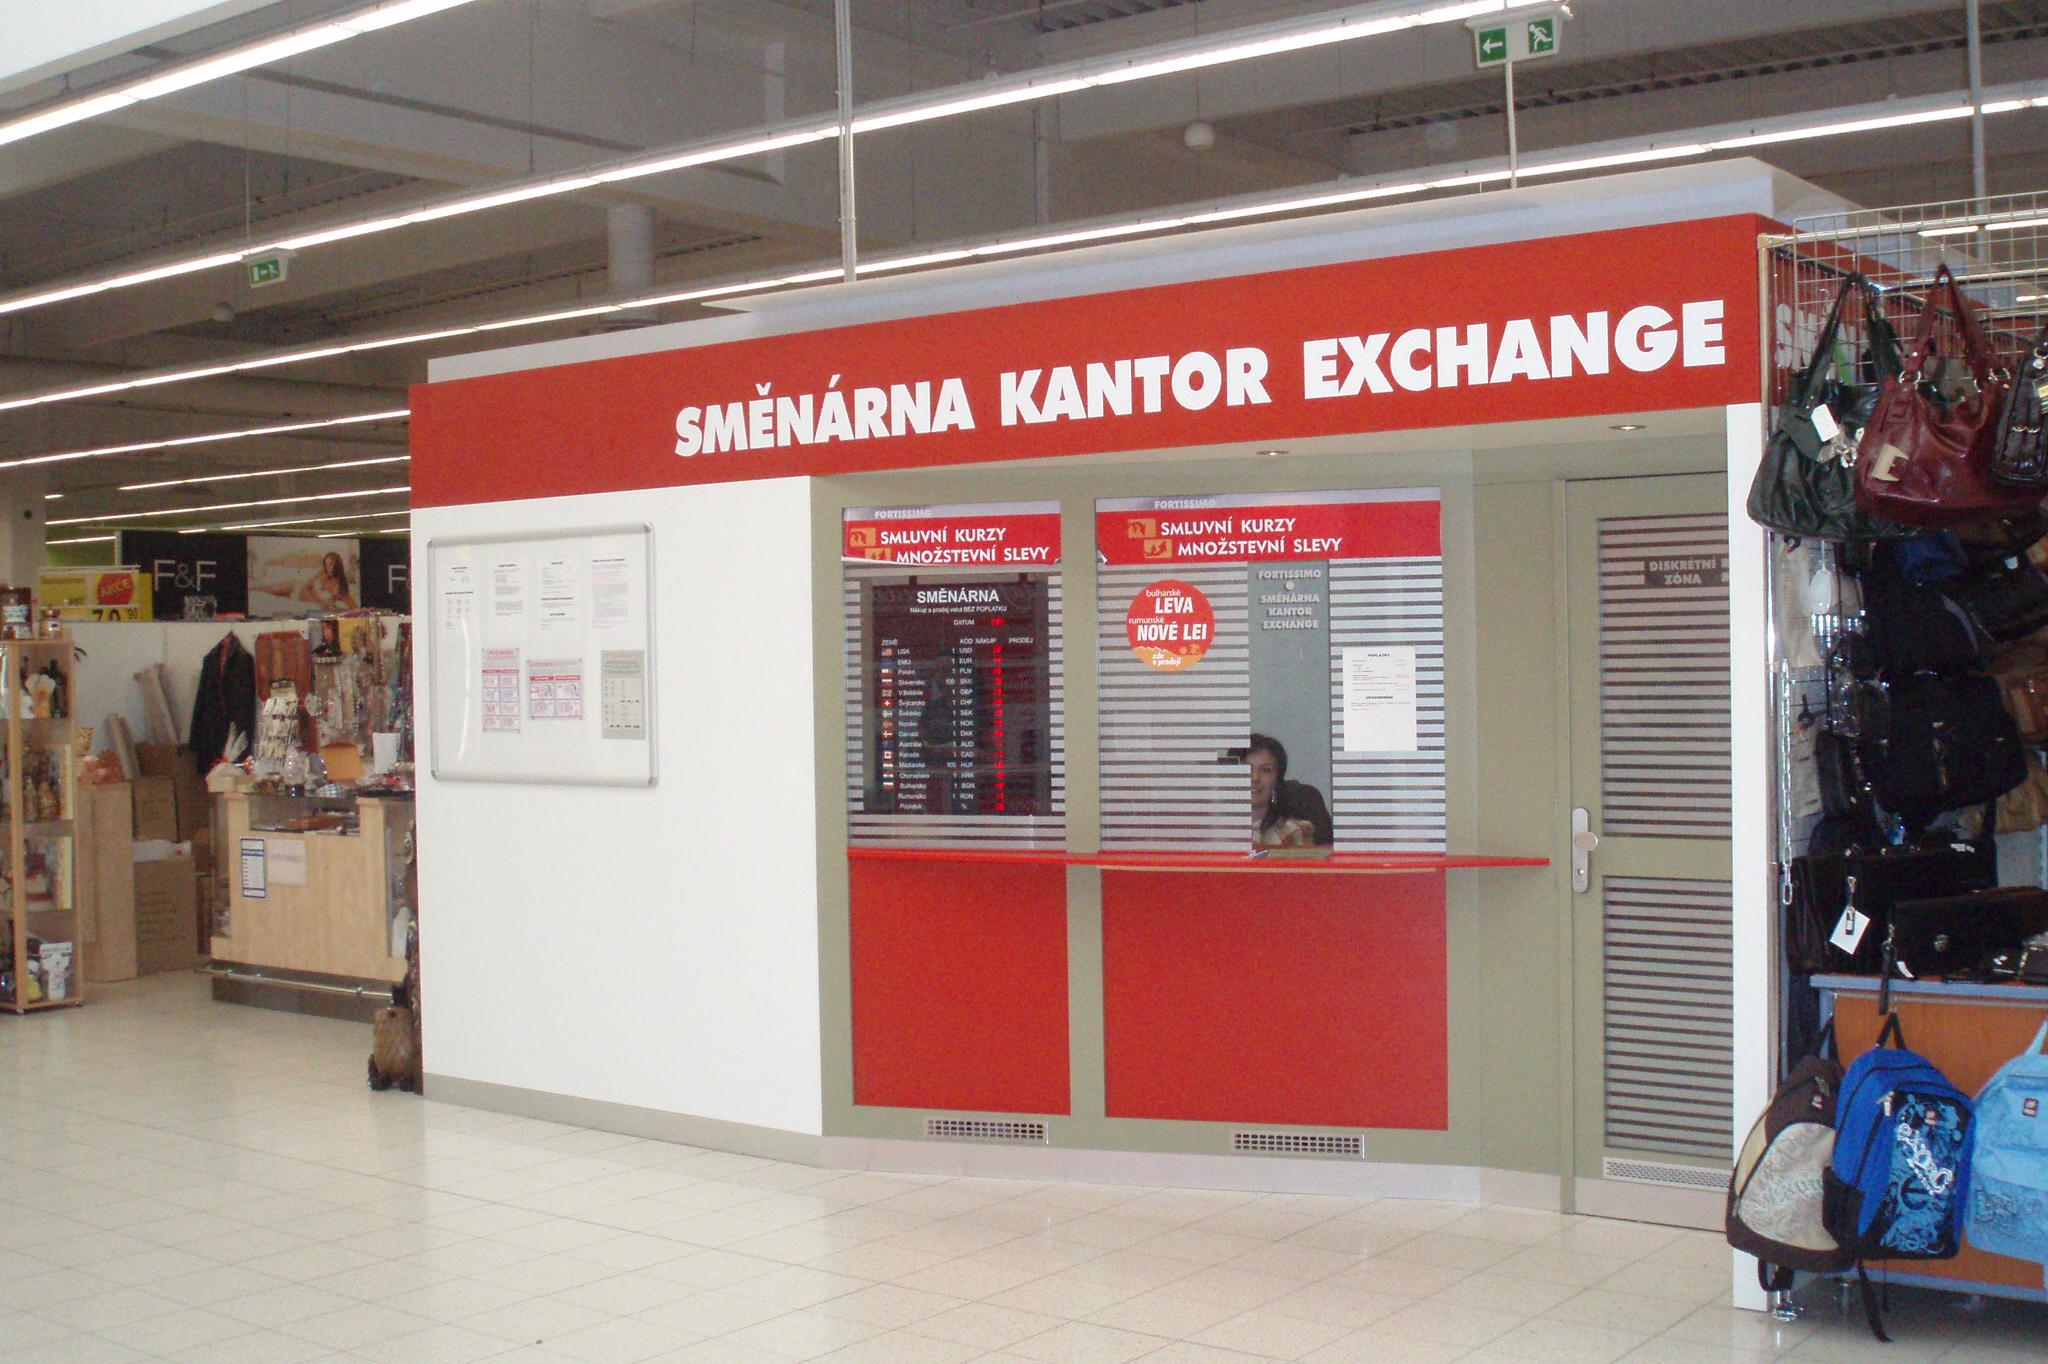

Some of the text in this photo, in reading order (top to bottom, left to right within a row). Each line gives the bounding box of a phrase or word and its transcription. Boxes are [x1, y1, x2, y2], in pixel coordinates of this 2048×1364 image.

[674, 374, 976, 457] SMĚNÁRNA
[1000, 347, 1273, 427] KANTOR
[1304, 299, 1727, 400] EXCHANGE
[1154, 498, 1216, 509] FORTISSIMO
[1161, 516, 1296, 536] SMLUVNÍ KURZY
[880, 526, 1007, 545] SMLUVNÍ KURZY
[896, 544, 1049, 564] MNOŽSTEVNÍ SLEVY
[1178, 535, 1343, 556] MNOŽSTEVNÍ SLEVY
[154, 560, 217, 591] F&F
[1258, 570, 1321, 580] FORTISSIMO
[917, 587, 1000, 604] SMĚNÁRNA
[1146, 588, 1182, 597] bulharské
[1260, 592, 1320, 604] SMĚNÁRNA
[1155, 596, 1194, 614] LEVA
[1268, 607, 1313, 617] KANTOR
[1128, 616, 1165, 625] rumunské
[1263, 619, 1319, 630] EXCHANGE
[1137, 621, 1208, 641] NOVÉ LEI
